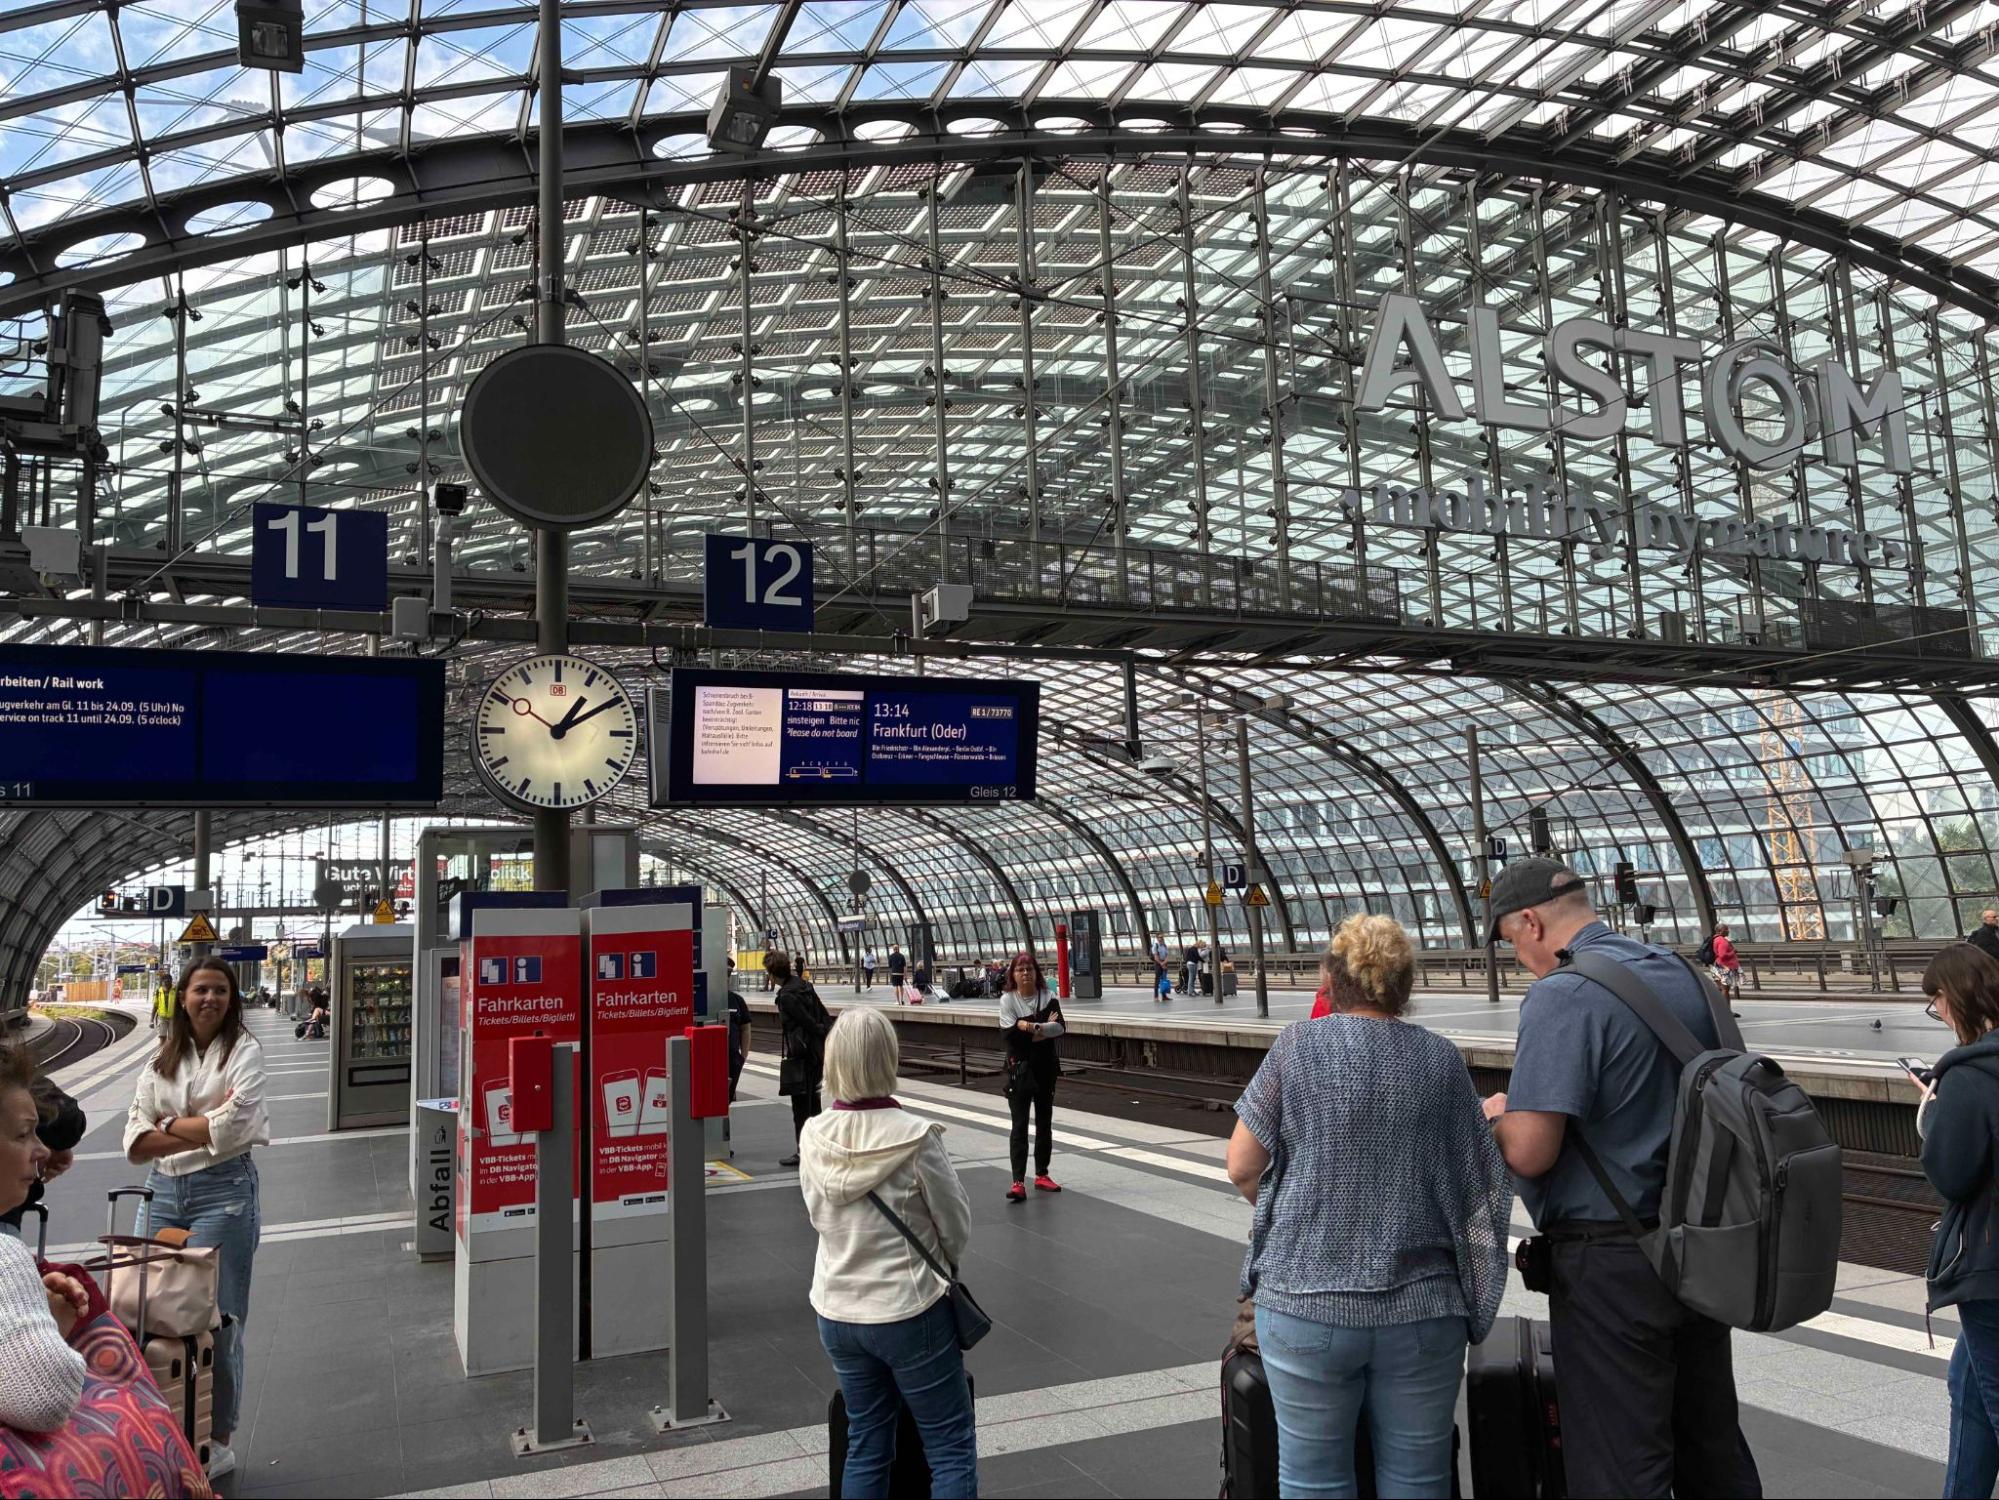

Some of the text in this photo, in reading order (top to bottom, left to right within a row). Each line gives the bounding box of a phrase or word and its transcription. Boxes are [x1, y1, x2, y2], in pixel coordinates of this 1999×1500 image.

[1354, 290, 1912, 474] ALSTOM
[1371, 473, 1882, 566] mobility by nature
[267, 510, 337, 580] 11
[731, 542, 802, 606] 12
[52, 677, 74, 688] Rail
[76, 678, 104, 689] work
[62, 701, 74, 710] Gl.
[76, 701, 89, 710] 11
[91, 702, 104, 710] bis
[106, 702, 136, 712] 24.09.
[139, 702, 149, 713] (5
[151, 703, 170, 713] Uhr)
[172, 704, 184, 712] No
[788, 702, 812, 710] 12:18
[874, 704, 909, 718] 13:14
[42, 714, 64, 723] track
[67, 714, 78, 723] 11
[81, 714, 102, 724] until
[104, 714, 134, 724] 24.09.
[138, 715, 148, 726] (5
[830, 716, 848, 725] Bitte
[811, 728, 820, 737] do
[822, 729, 834, 737] not
[836, 728, 858, 738] board
[874, 722, 966, 740] Frankfurt (Oder)
[13, 783, 30, 797] 11
[970, 786, 1017, 798] Gleis 12
[1494, 839, 1505, 856] D
[324, 866, 372, 881] Gute
[1227, 866, 1240, 884] D
[153, 887, 174, 910] D
[478, 996, 564, 1012] Fahrkarten
[596, 990, 677, 1006] Fahrkarten
[479, 1012, 576, 1026] Tickets/Billets/Biglietti
[598, 1006, 688, 1020] Tickets/Billets/Biglietti
[600, 1145, 642, 1154] VBB-Tickets
[480, 1154, 526, 1164] VBB-Tickets
[622, 1153, 657, 1162] Navigator
[429, 1149, 451, 1232] Abfall
